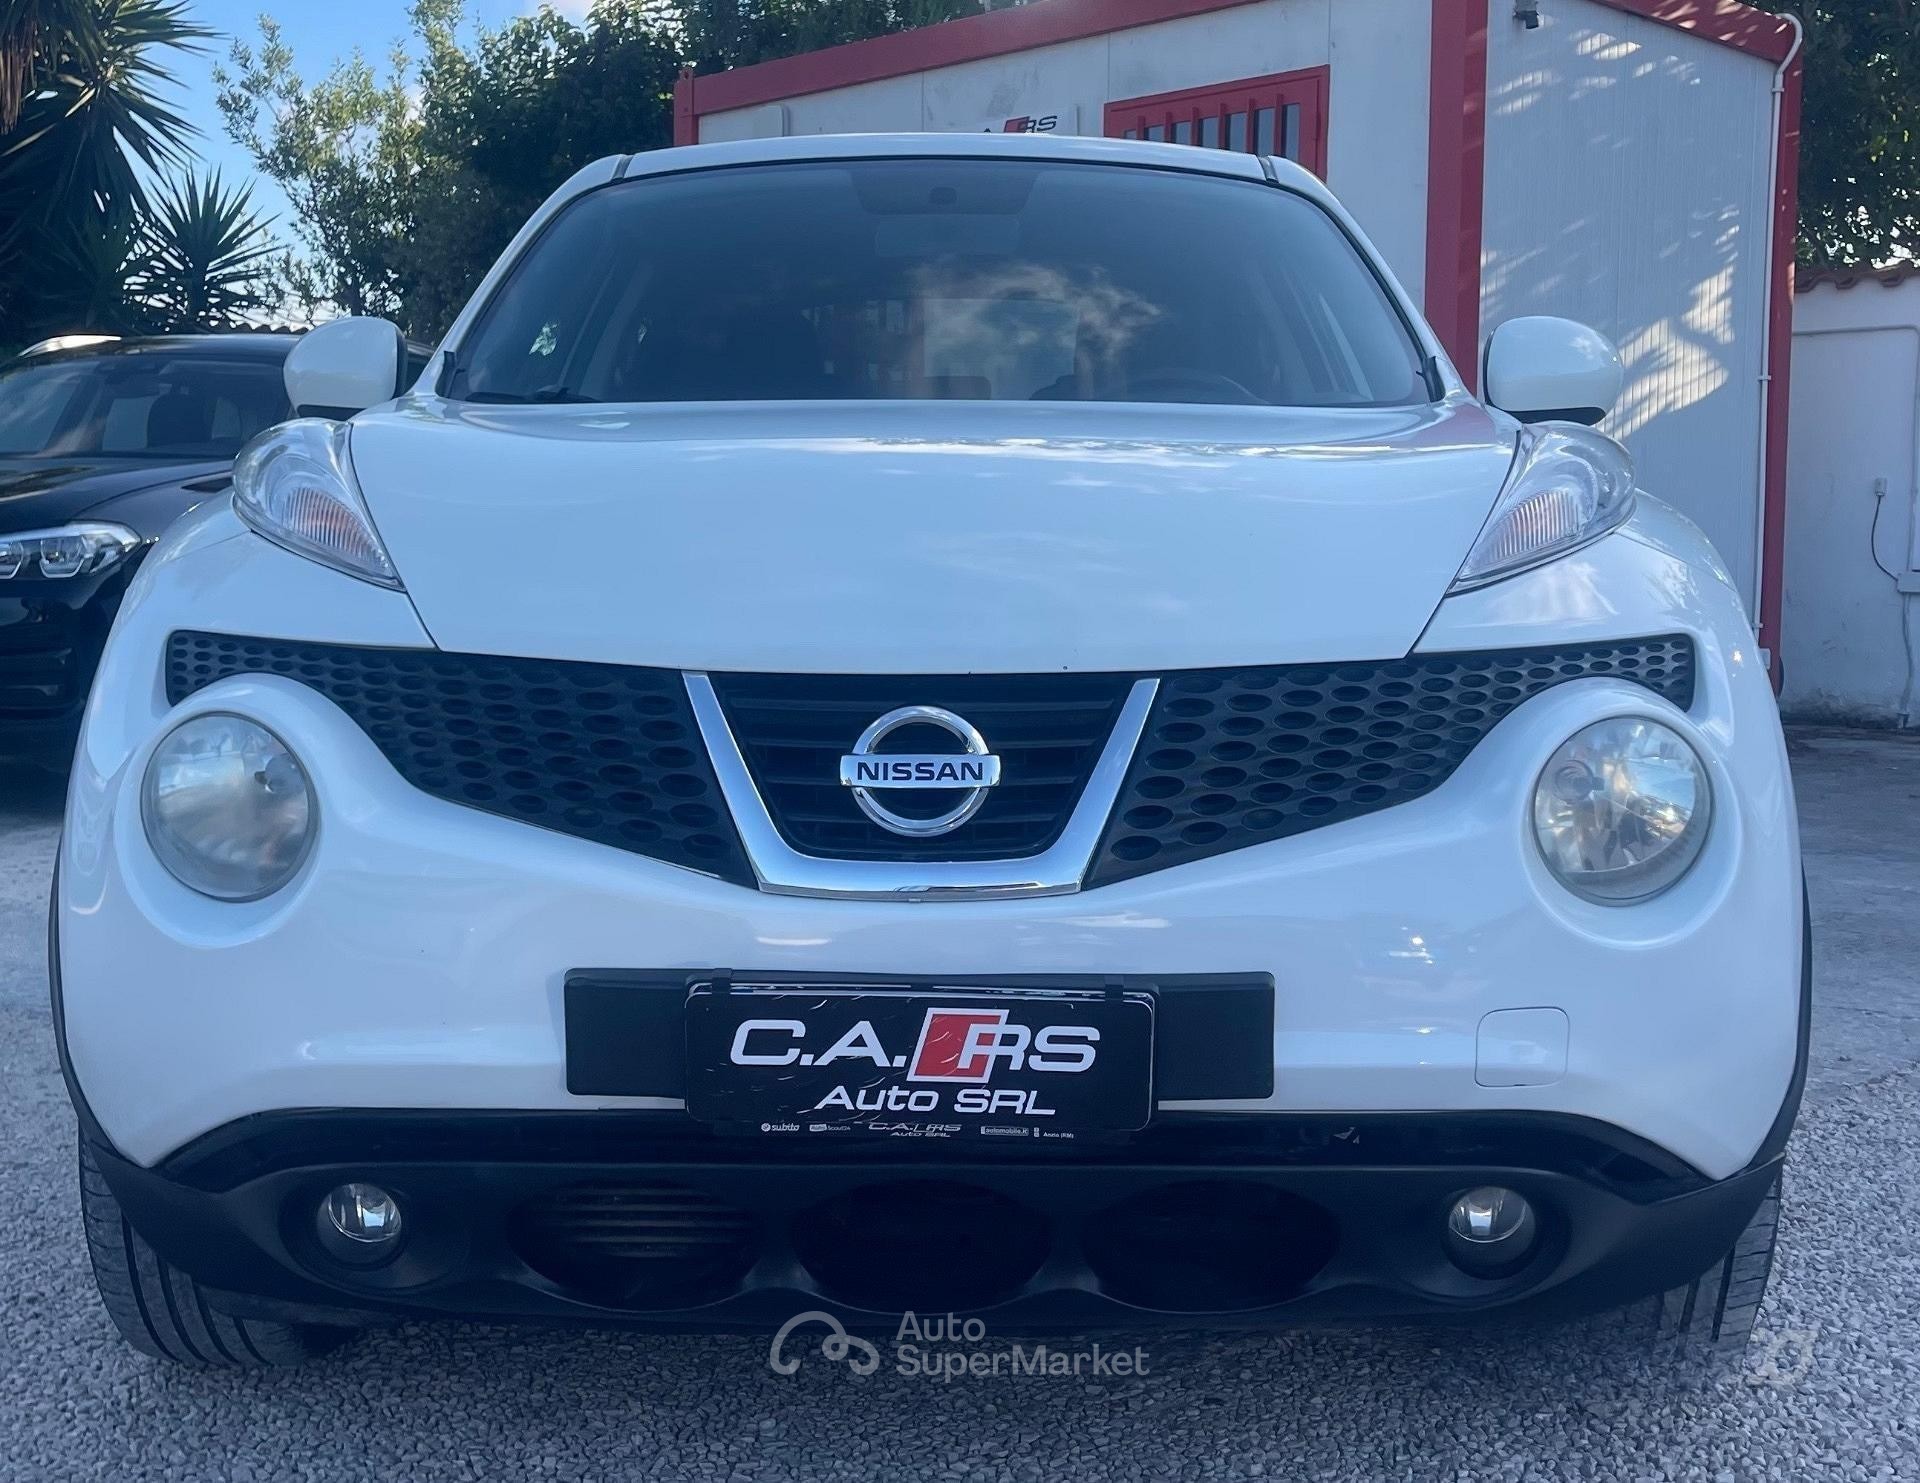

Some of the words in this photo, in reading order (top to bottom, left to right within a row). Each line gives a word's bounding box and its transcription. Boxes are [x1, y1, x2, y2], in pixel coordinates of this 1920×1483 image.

[857, 762, 983, 781] NISSAN
[814, 1085, 939, 1113] Auto
[953, 1087, 1056, 1116] SRL
